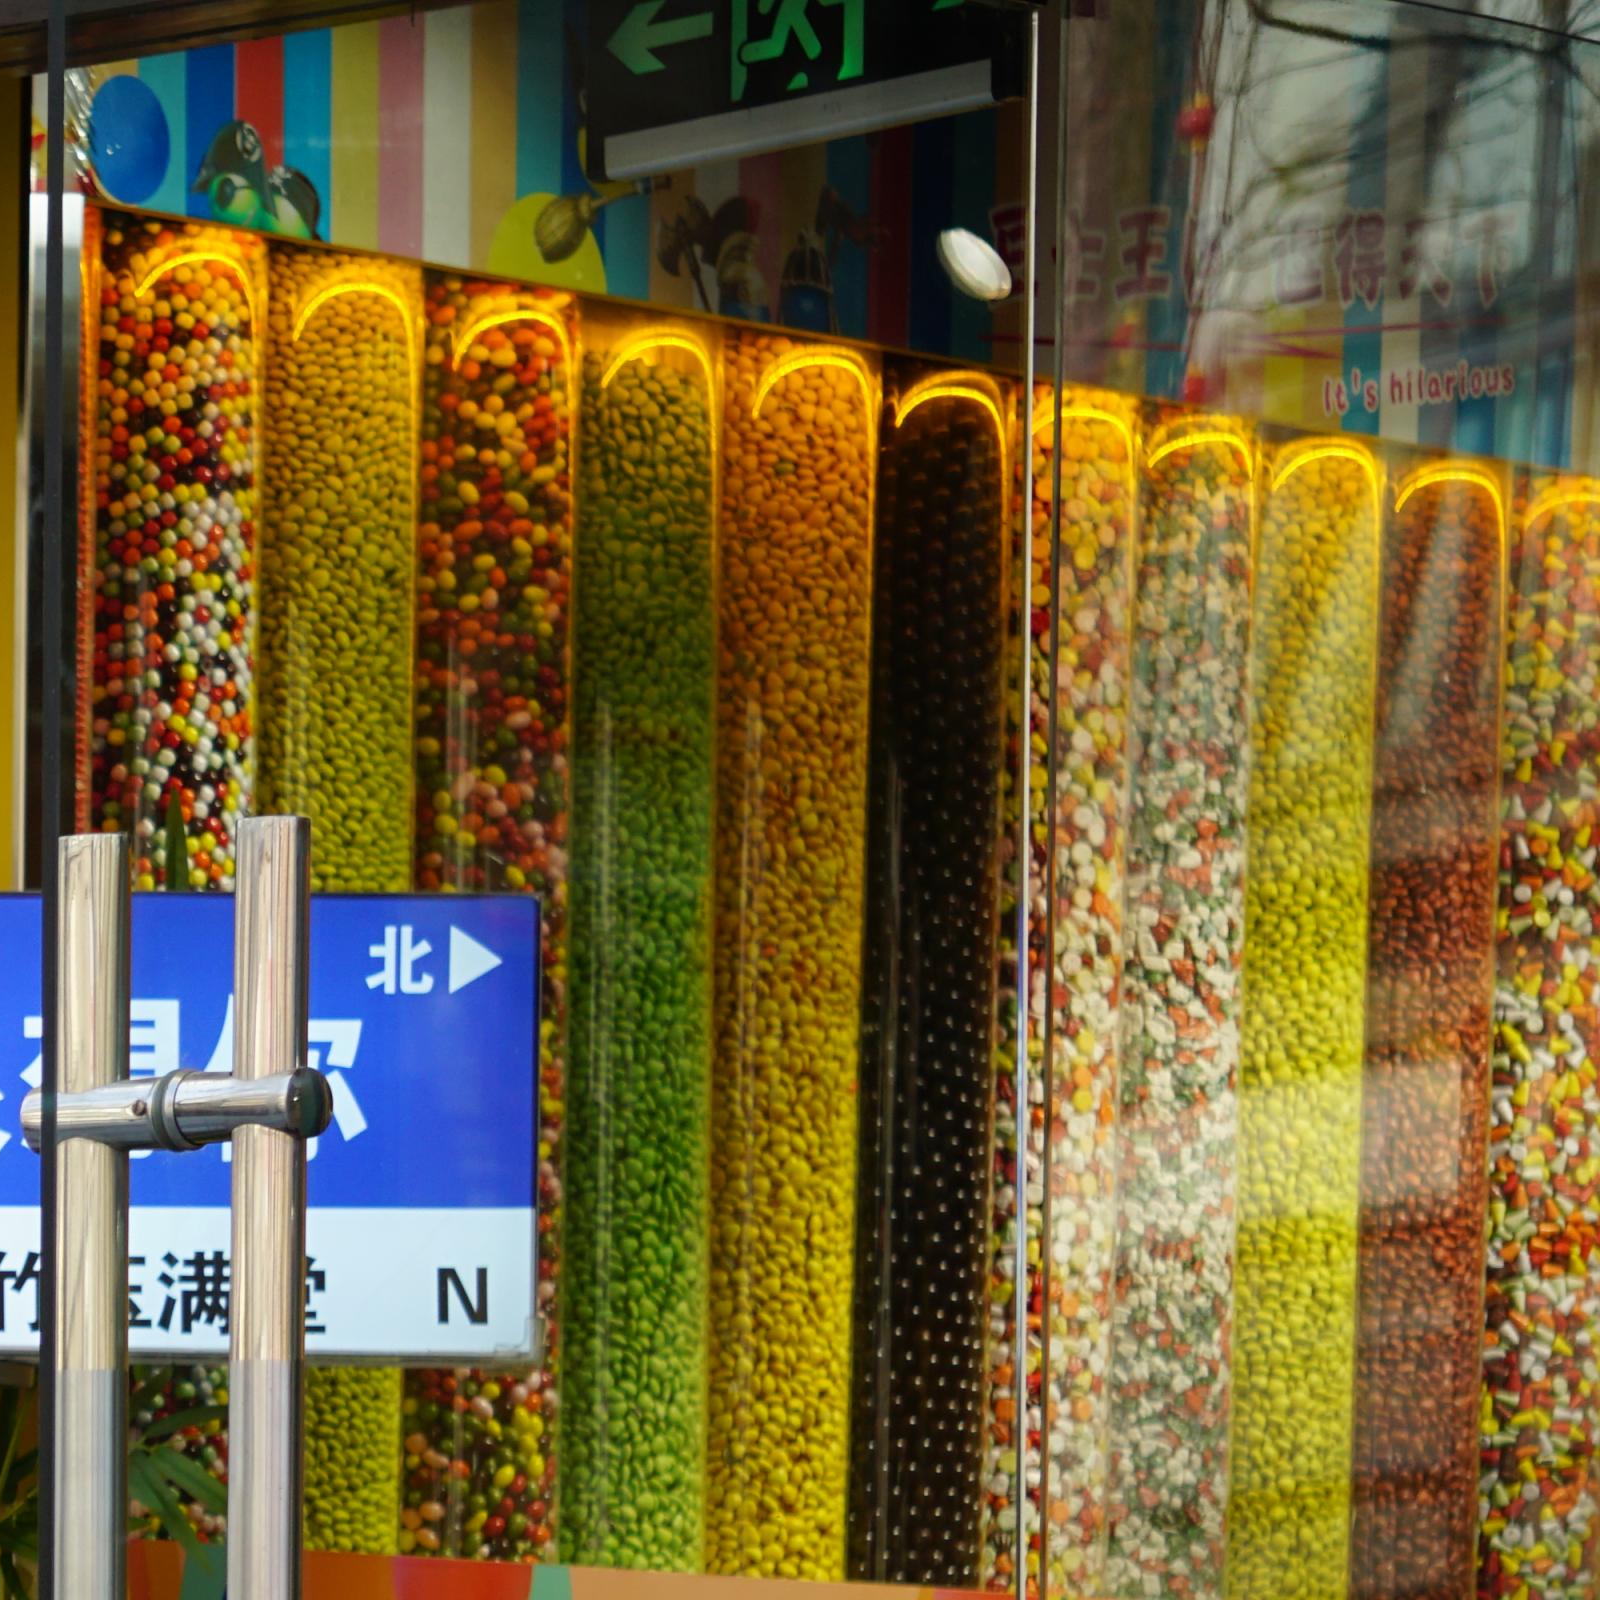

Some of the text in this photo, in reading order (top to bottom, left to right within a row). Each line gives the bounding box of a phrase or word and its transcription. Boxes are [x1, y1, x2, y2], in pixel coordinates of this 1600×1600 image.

[1322, 360, 1514, 417] It's hilarious
[365, 925, 434, 995] 北
[437, 1266, 488, 1324] N
